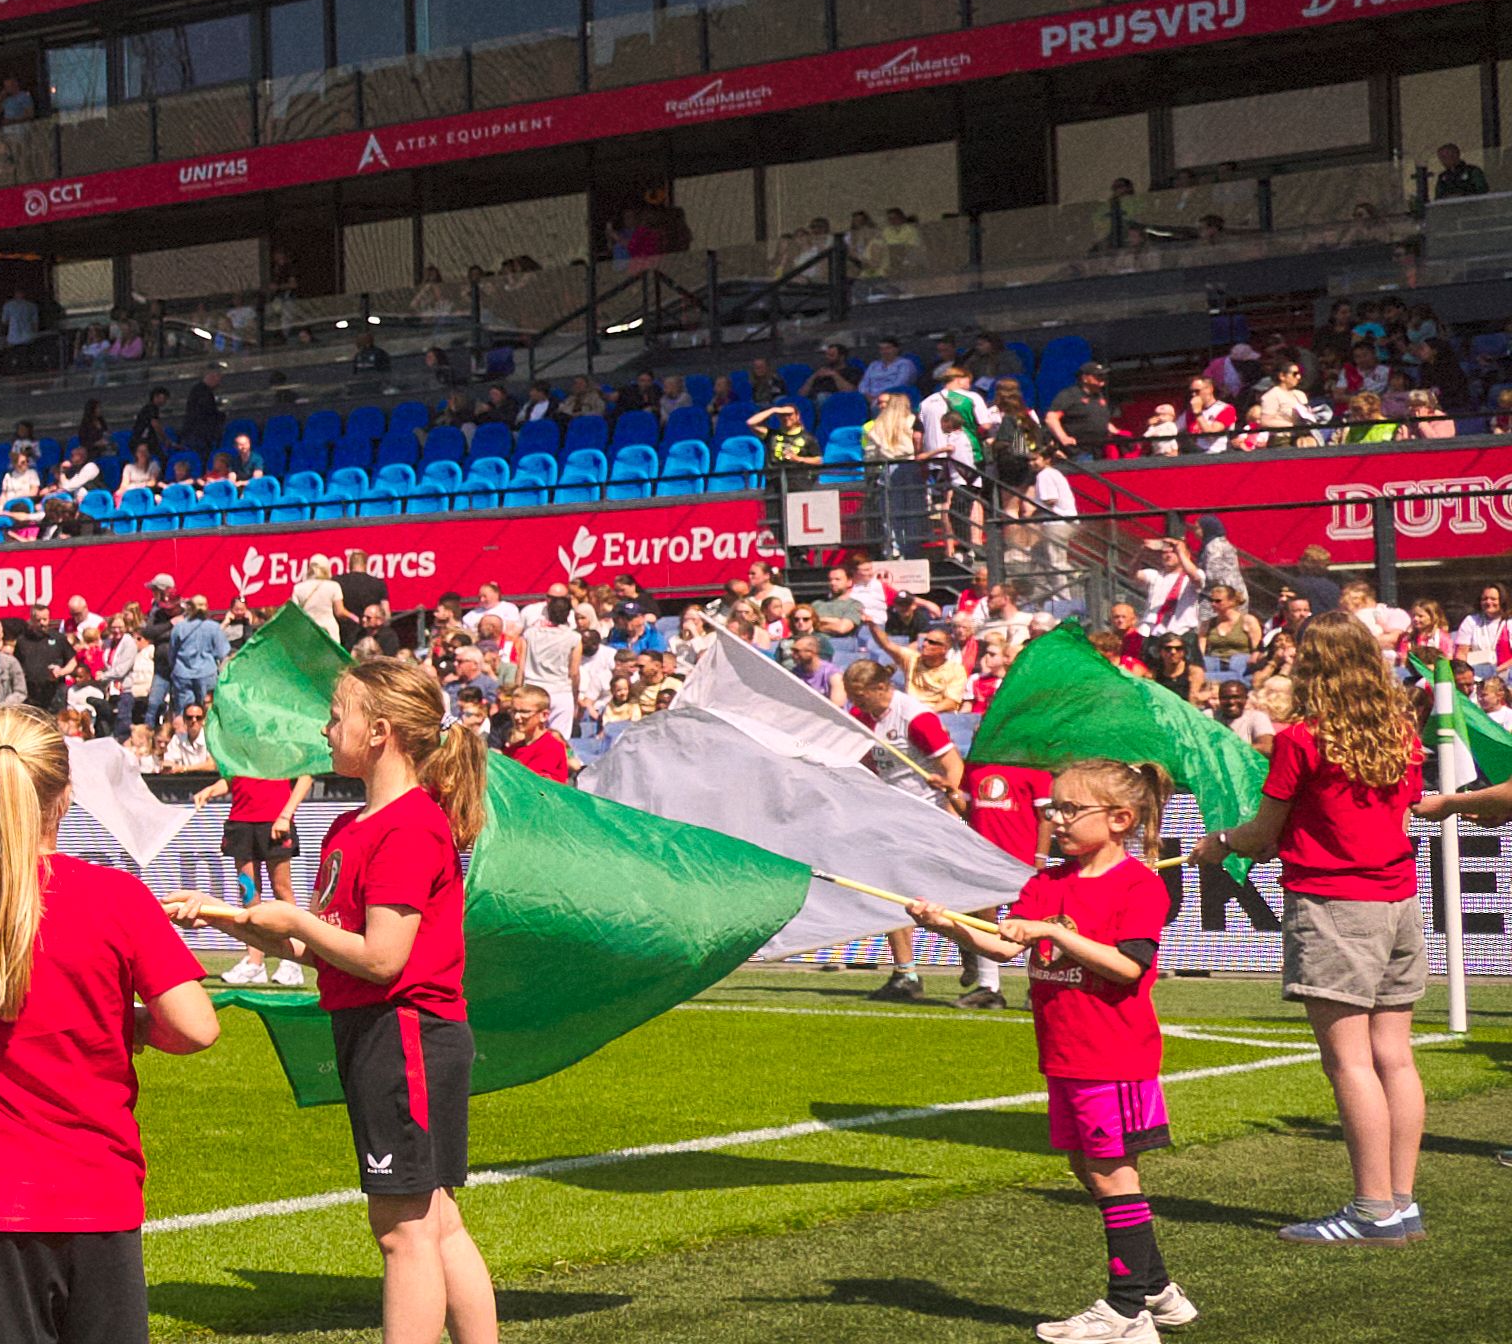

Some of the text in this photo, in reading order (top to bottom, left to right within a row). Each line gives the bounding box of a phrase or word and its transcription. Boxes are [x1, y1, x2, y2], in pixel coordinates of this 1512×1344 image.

[855, 52, 971, 82] RentalMatch
[665, 85, 773, 113] RentalMatch
[395, 116, 554, 153] ATEX EQUIPMENT
[179, 159, 248, 183] UNIT45
[49, 183, 84, 204] CCT
[801, 502, 824, 535] L
